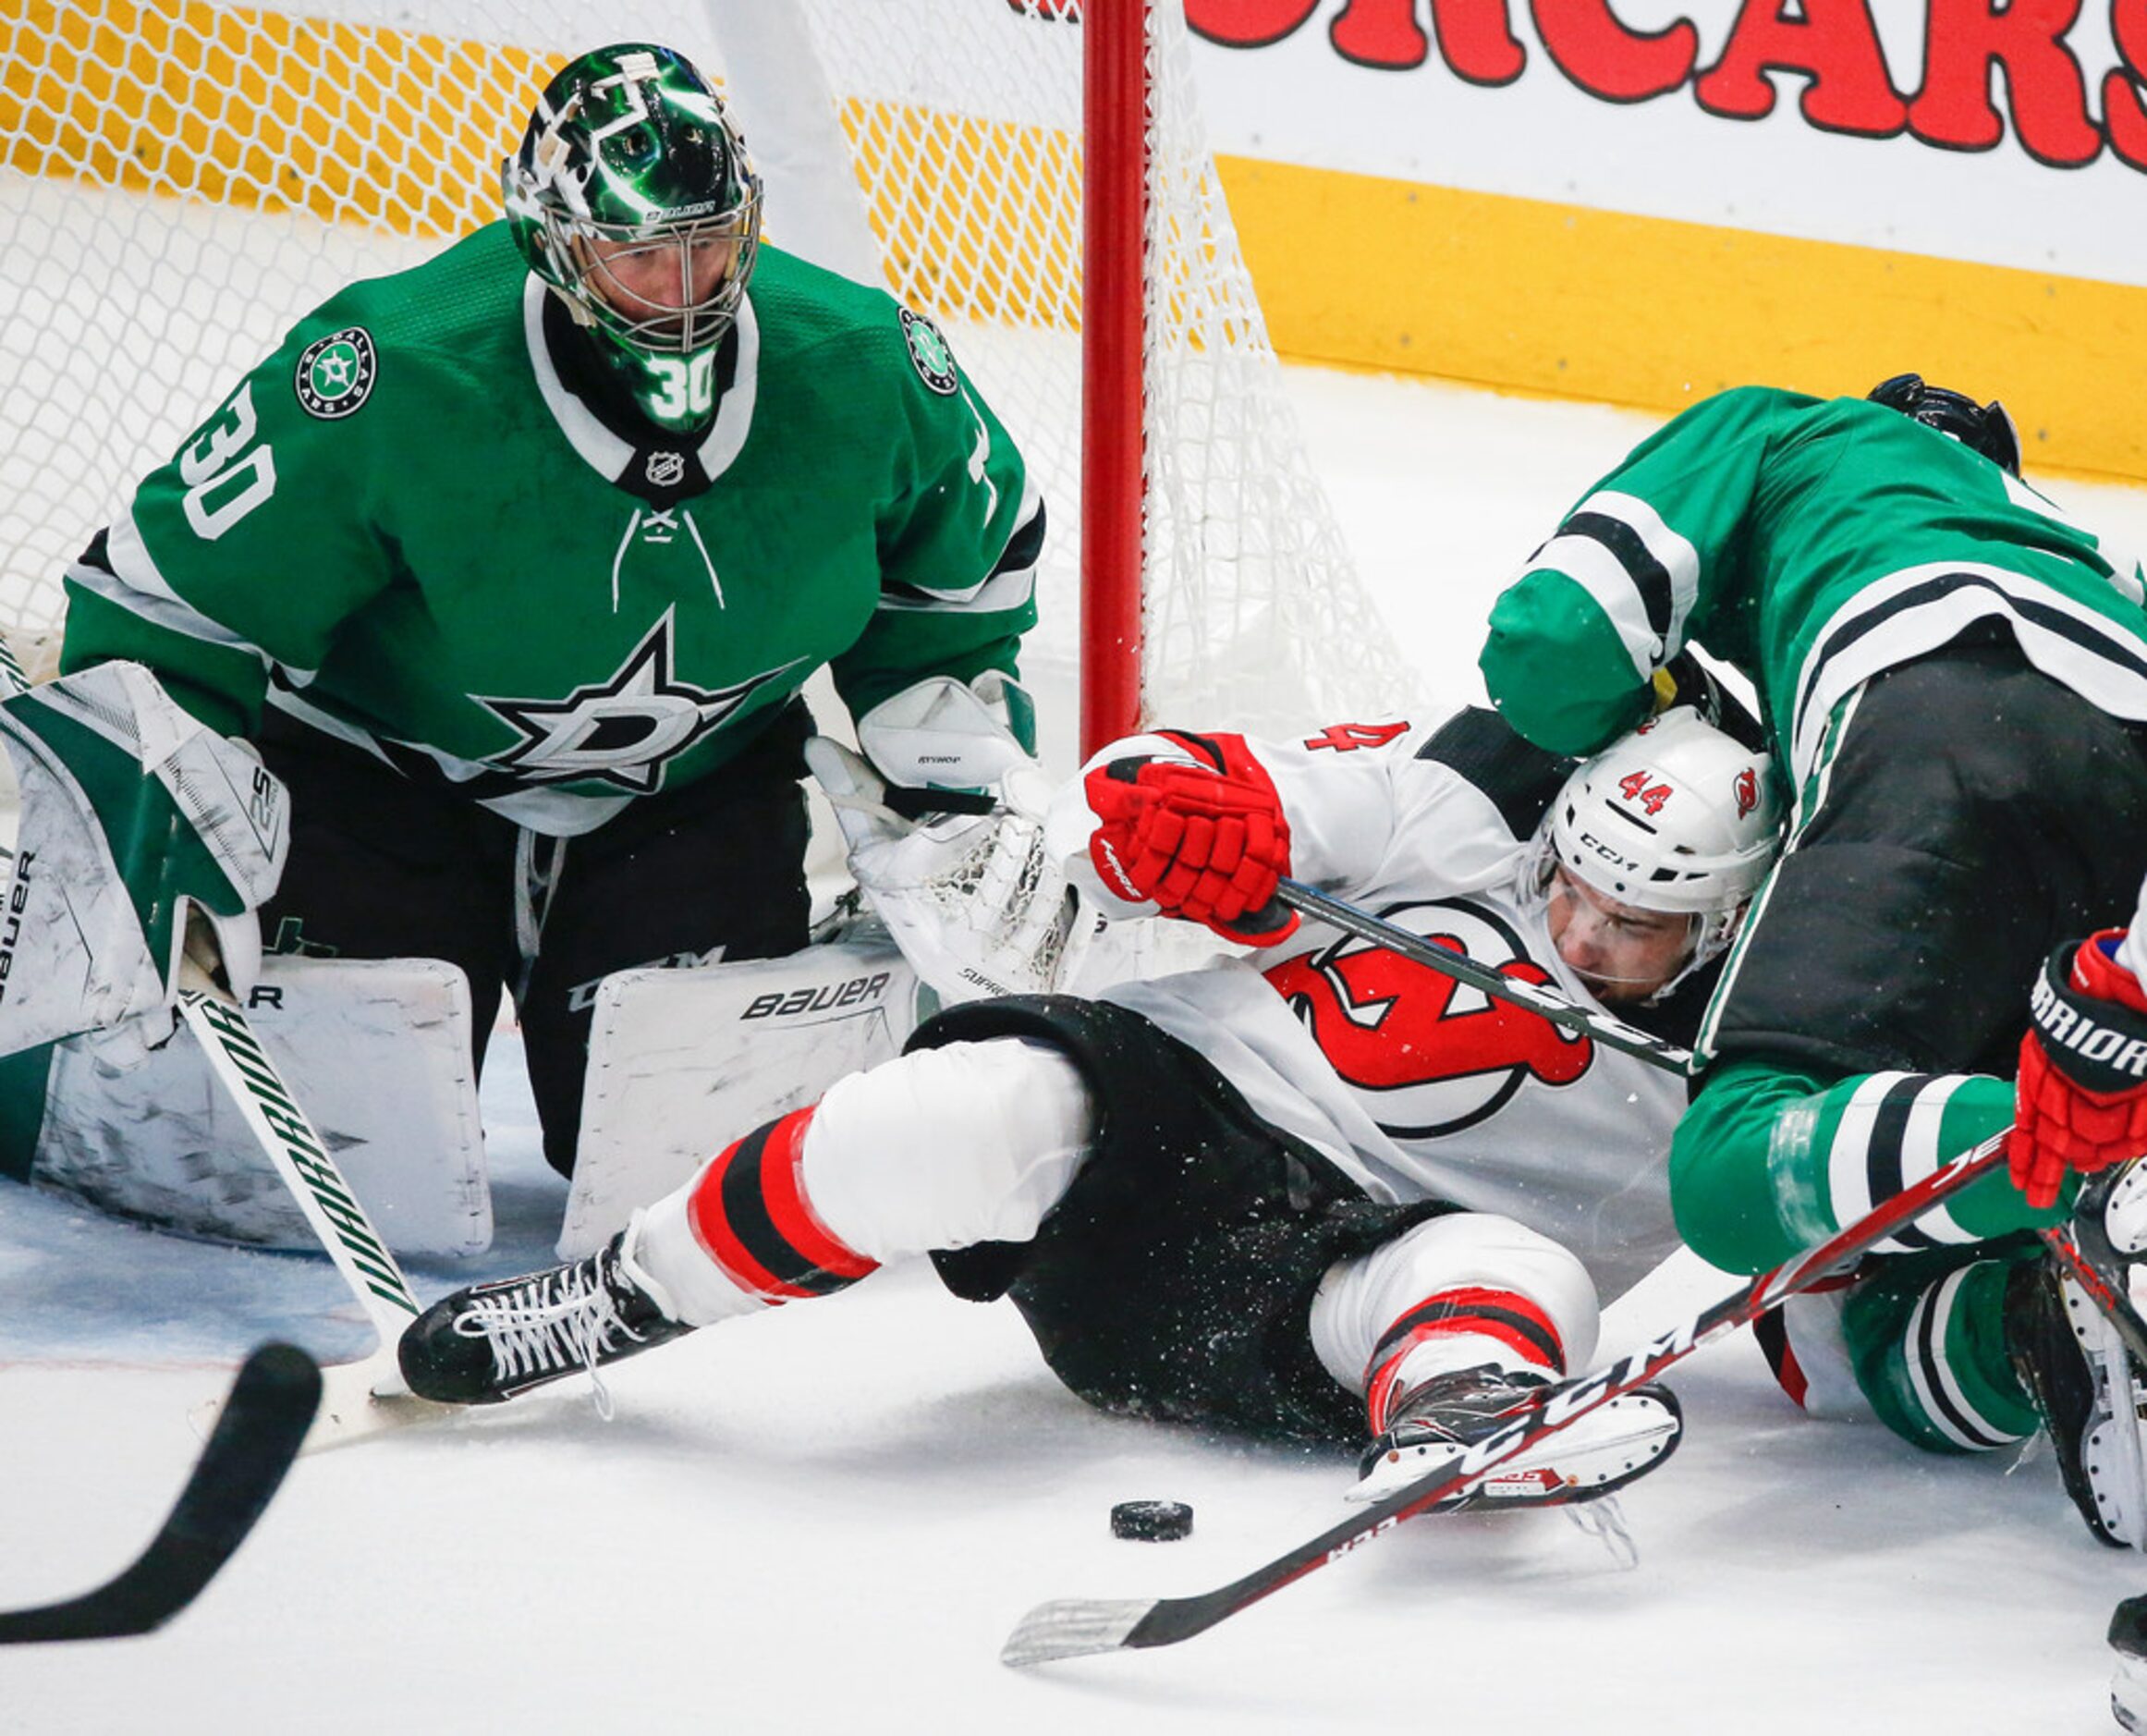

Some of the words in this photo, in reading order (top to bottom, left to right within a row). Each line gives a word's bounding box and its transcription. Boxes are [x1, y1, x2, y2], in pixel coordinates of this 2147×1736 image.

[648, 350, 717, 419] 30
[179, 380, 277, 542] 30
[1618, 769, 1674, 816] 44
[739, 972, 891, 1021] BAUER
[2031, 956, 2147, 1077] RRIOR
[200, 998, 421, 1316] WARRIOR
[1459, 1325, 1699, 1476] CCM
